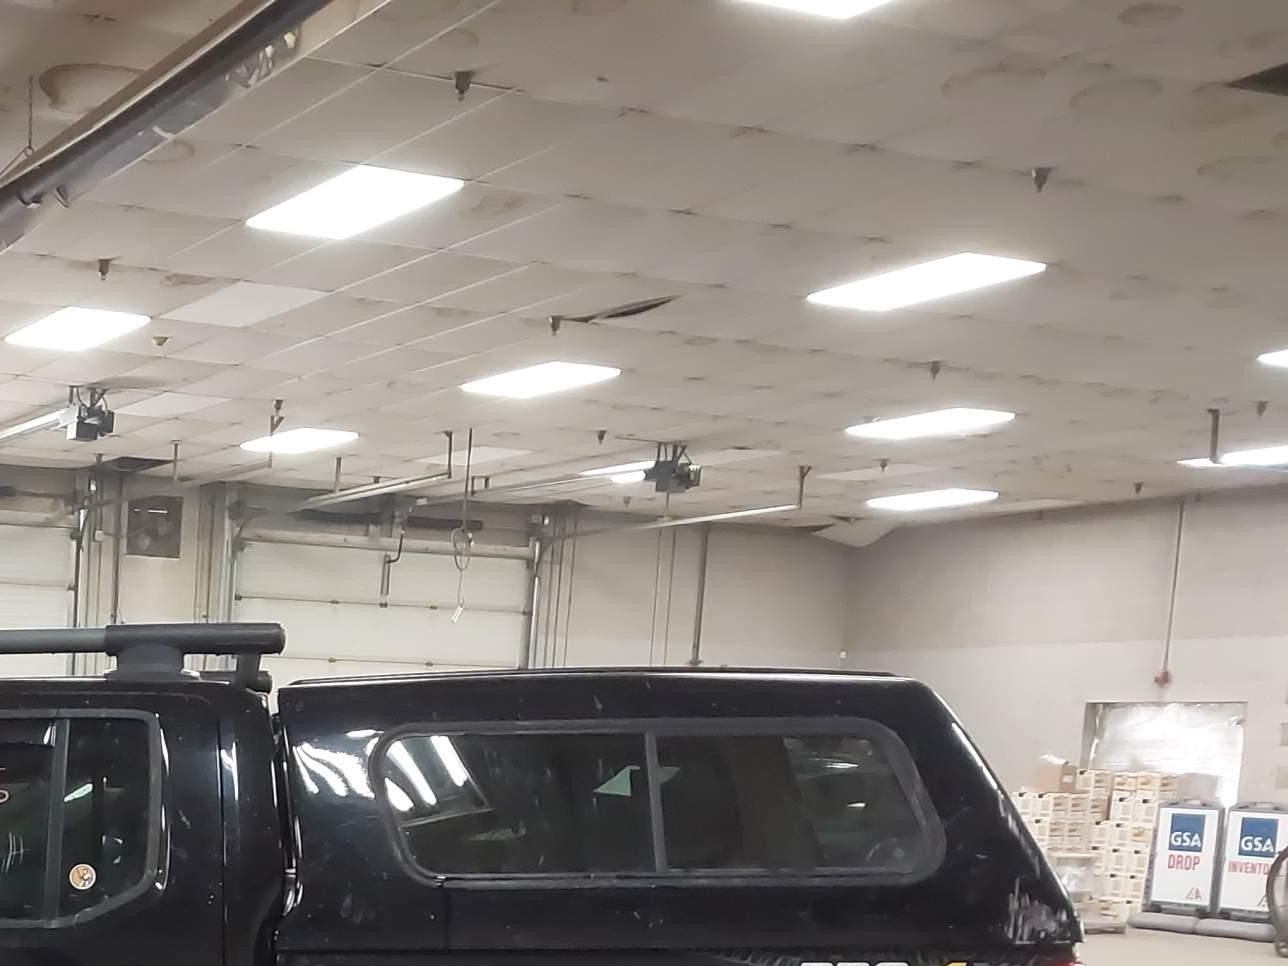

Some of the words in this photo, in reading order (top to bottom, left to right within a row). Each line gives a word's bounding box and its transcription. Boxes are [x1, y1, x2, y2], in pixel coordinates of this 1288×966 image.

[1170, 831, 1202, 848] GSA
[1240, 835, 1275, 853] GSA
[1167, 854, 1201, 871] DROP
[1228, 860, 1270, 875] INVENTO
